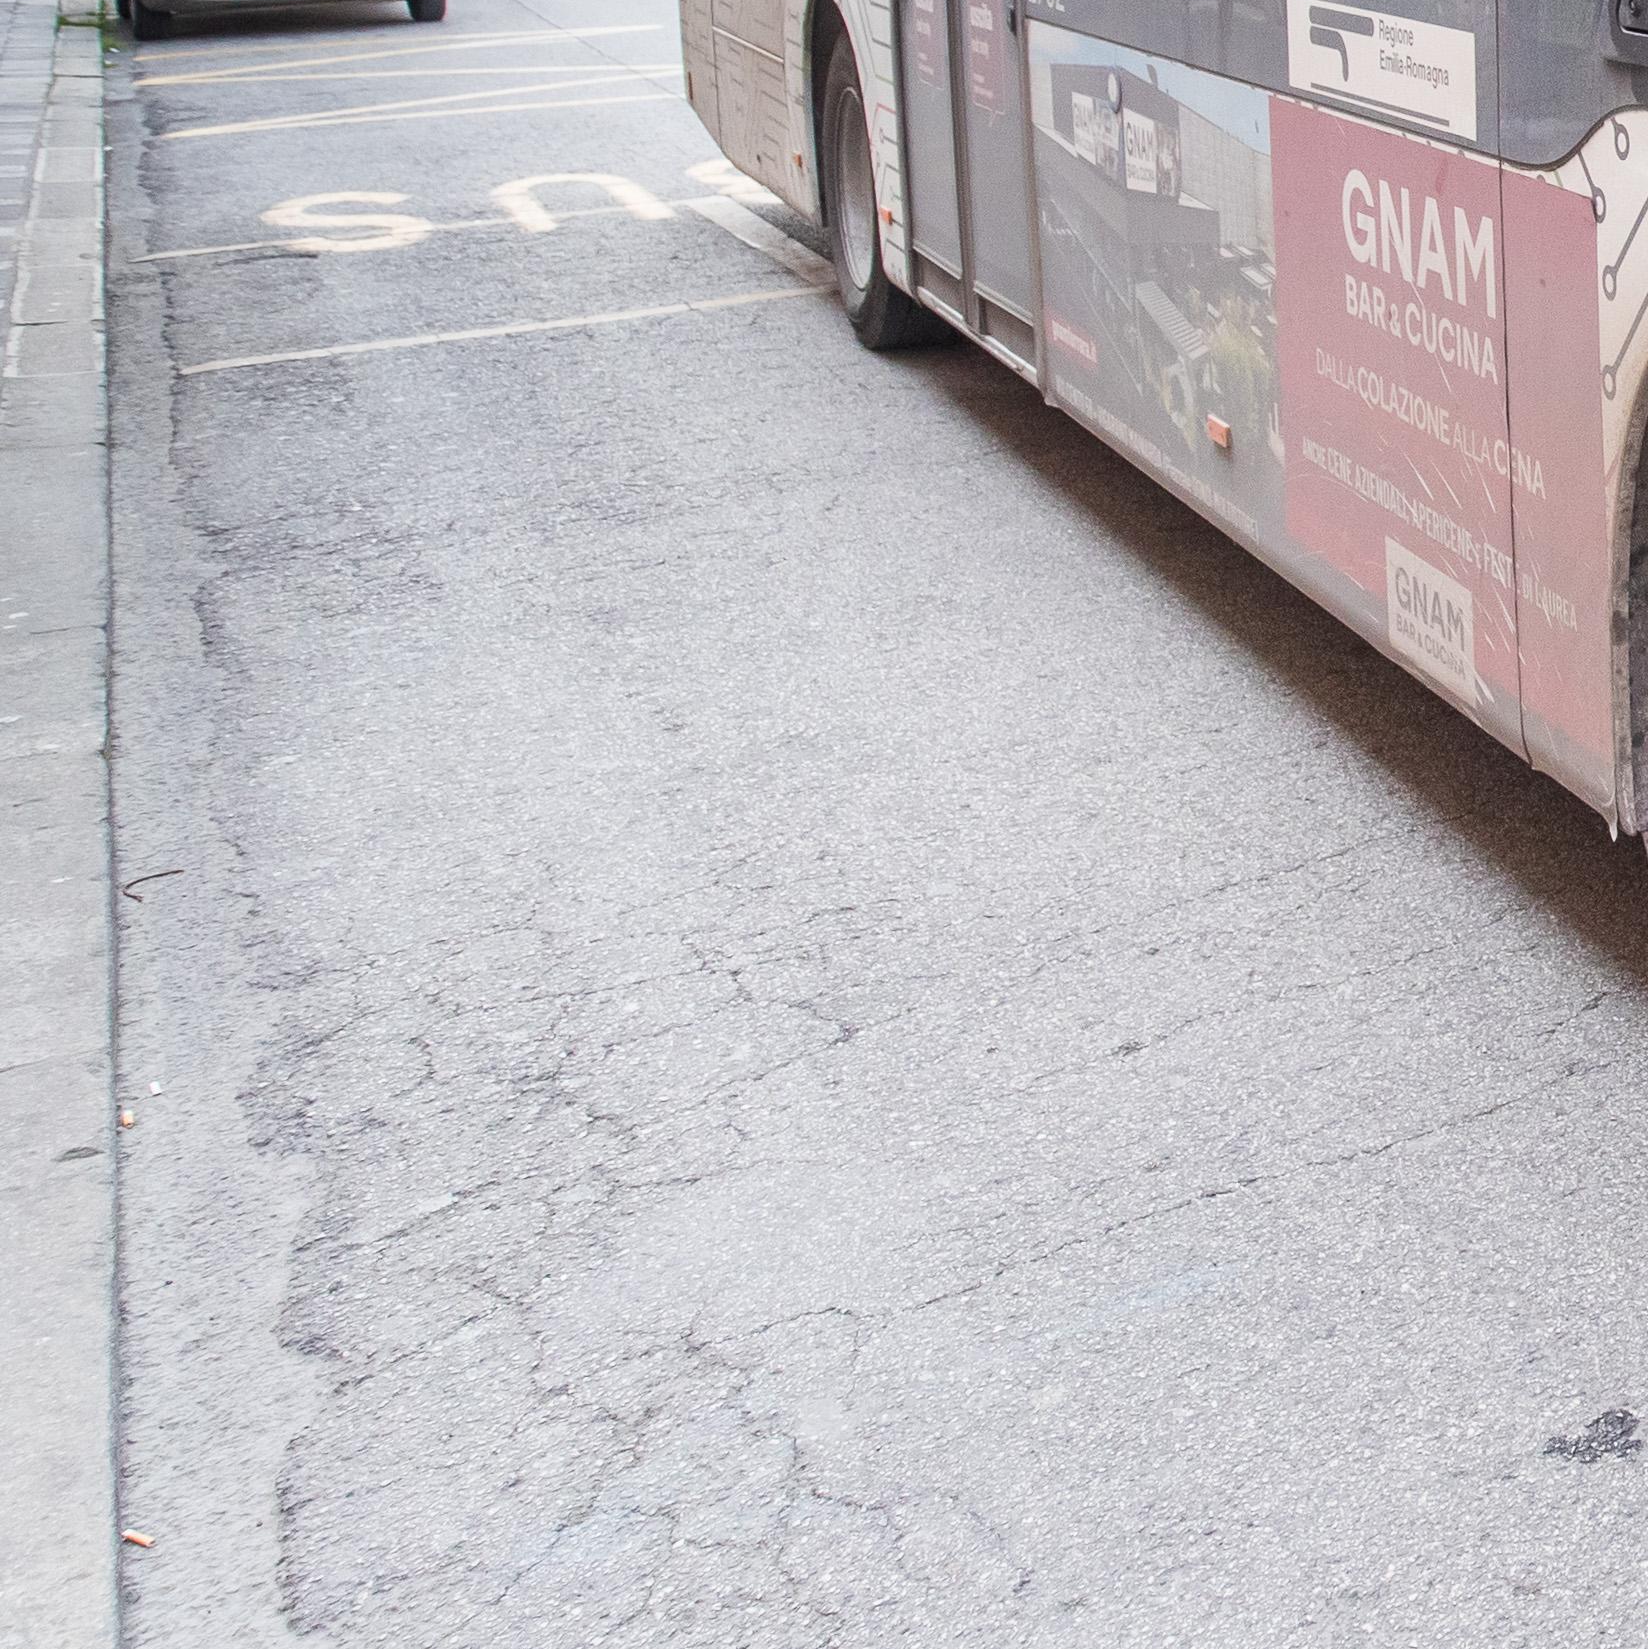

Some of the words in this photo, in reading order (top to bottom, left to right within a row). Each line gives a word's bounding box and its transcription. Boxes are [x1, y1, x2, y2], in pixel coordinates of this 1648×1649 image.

[1378, 19, 1415, 48] Regione
[1342, 168, 1497, 319] GNAM
[1345, 273, 1388, 337] BAR
[1389, 303, 1402, 339] &
[1404, 295, 1499, 386] CUCINA
[1316, 347, 1356, 394] DALLA
[1356, 365, 1451, 446] COLAZIONE
[1451, 421, 1493, 468] ALLA
[1395, 565, 1466, 653] GNAM
